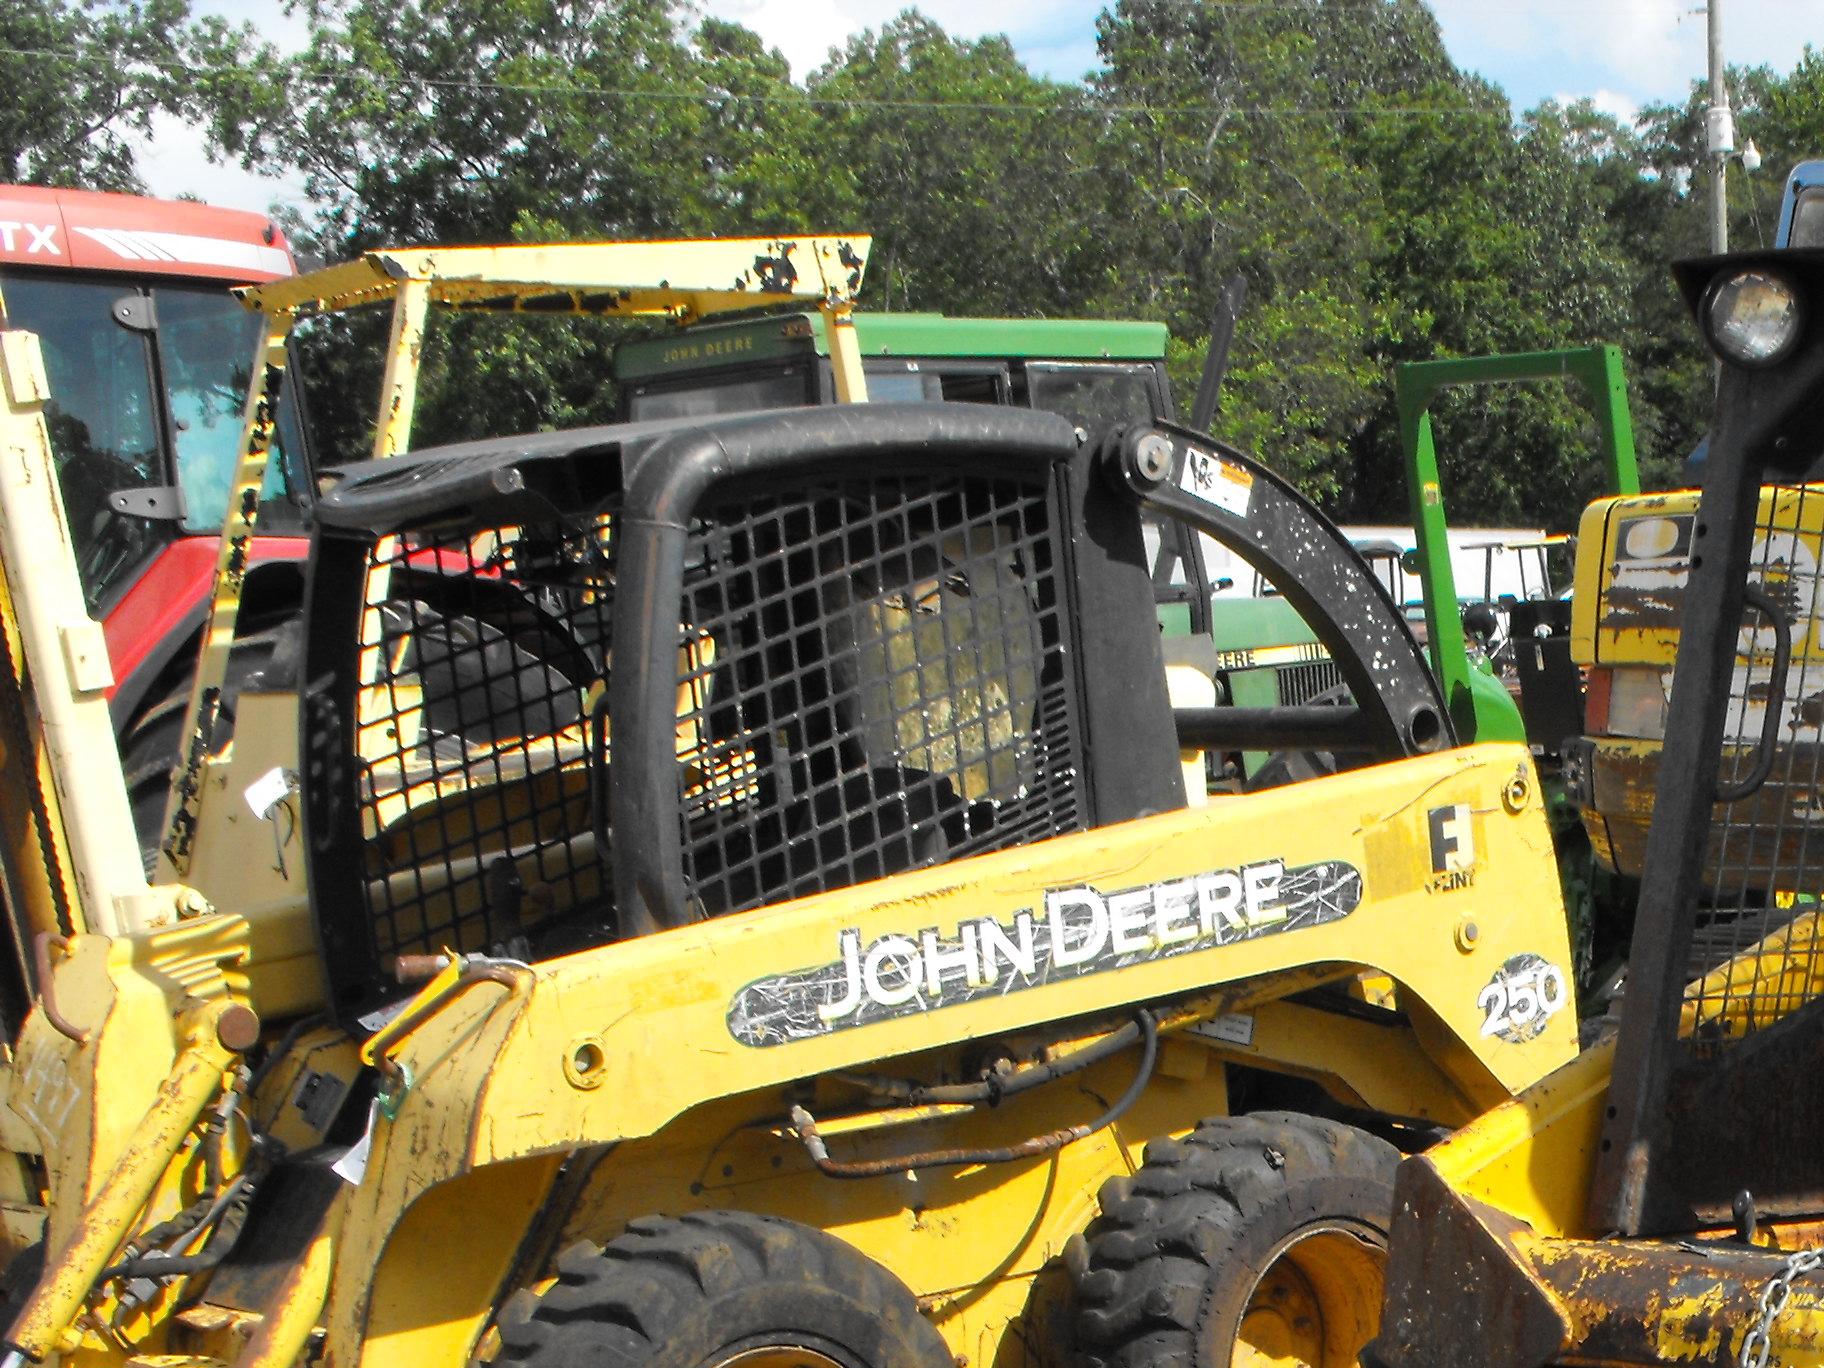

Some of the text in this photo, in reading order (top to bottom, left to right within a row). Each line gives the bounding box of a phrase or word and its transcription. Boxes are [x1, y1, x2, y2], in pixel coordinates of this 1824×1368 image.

[663, 336, 753, 363] JOHN DEERE
[818, 858, 1288, 1021] JOHN DEERE
[1476, 963, 1567, 1039] 250
